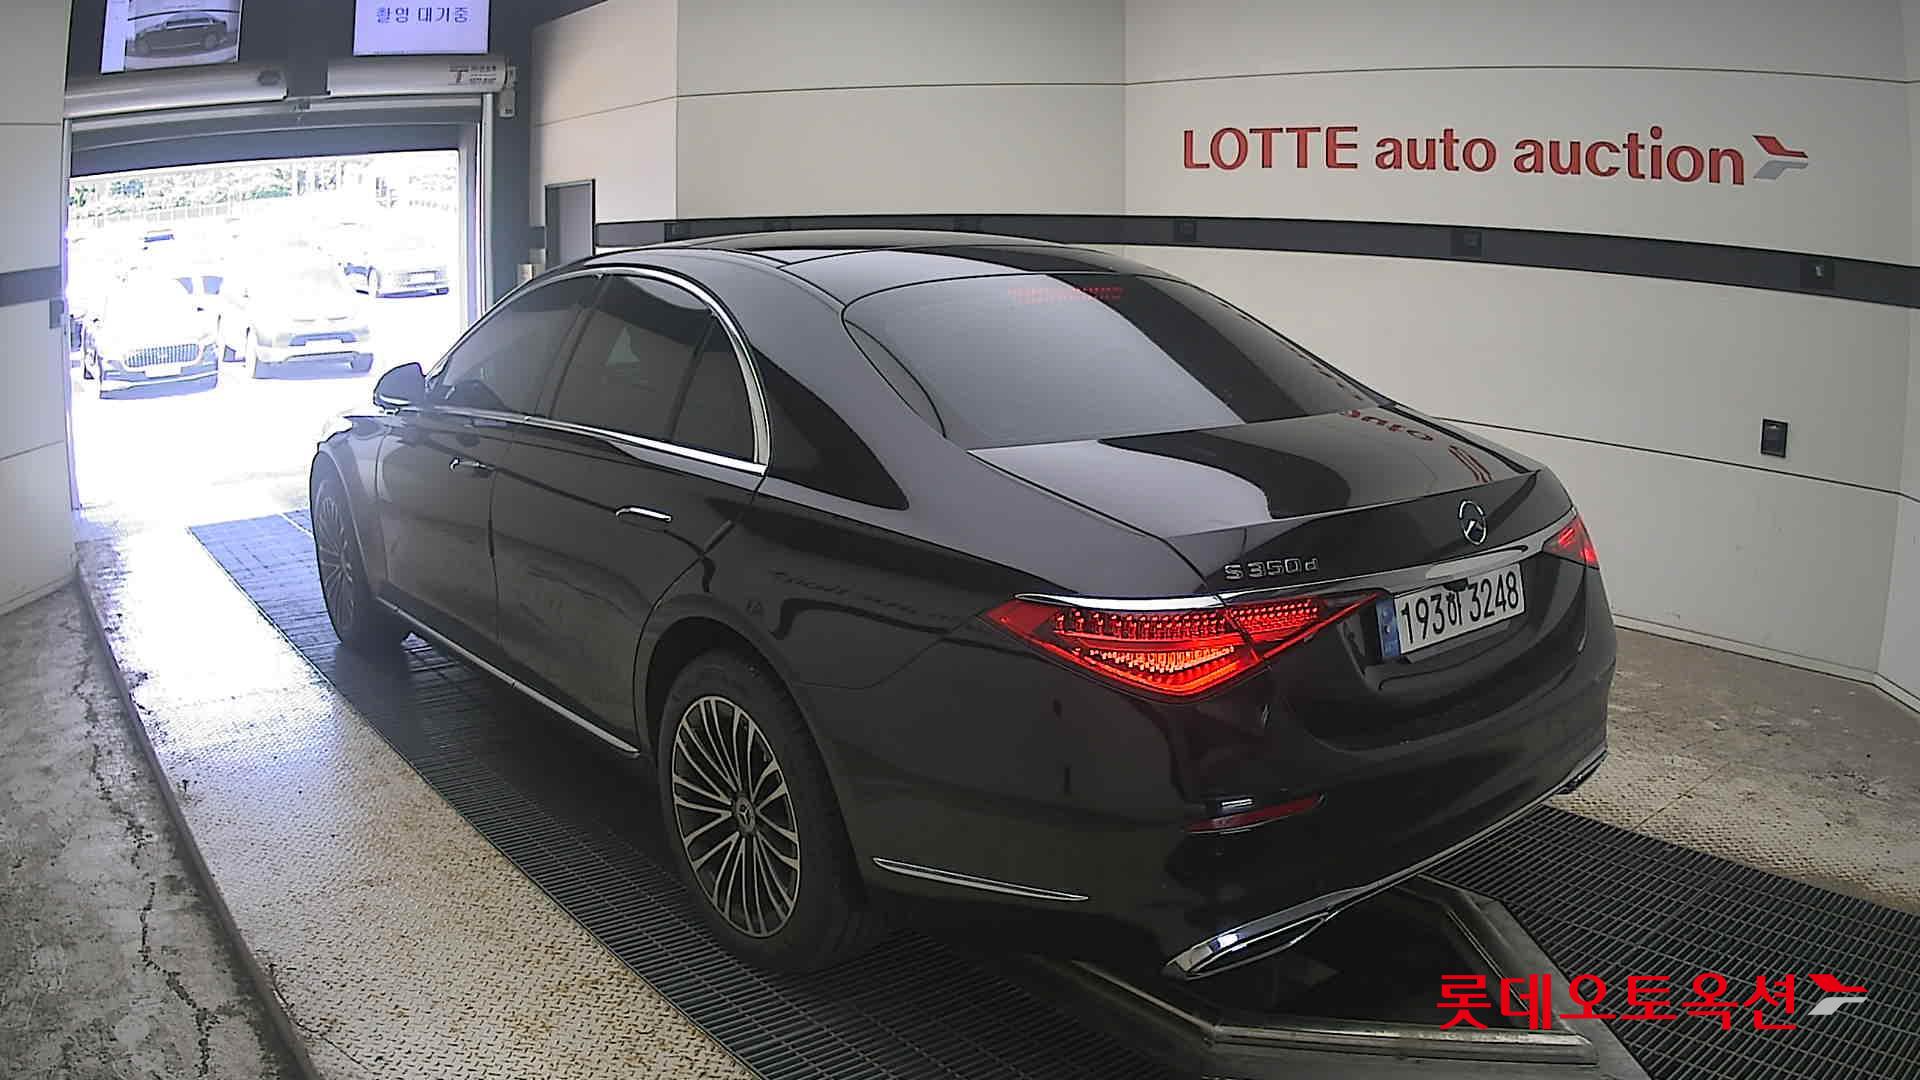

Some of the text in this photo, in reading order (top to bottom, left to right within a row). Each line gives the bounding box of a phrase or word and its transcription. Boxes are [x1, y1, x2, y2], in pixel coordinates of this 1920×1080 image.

[1183, 125, 1745, 186] LOTTE auto auction
